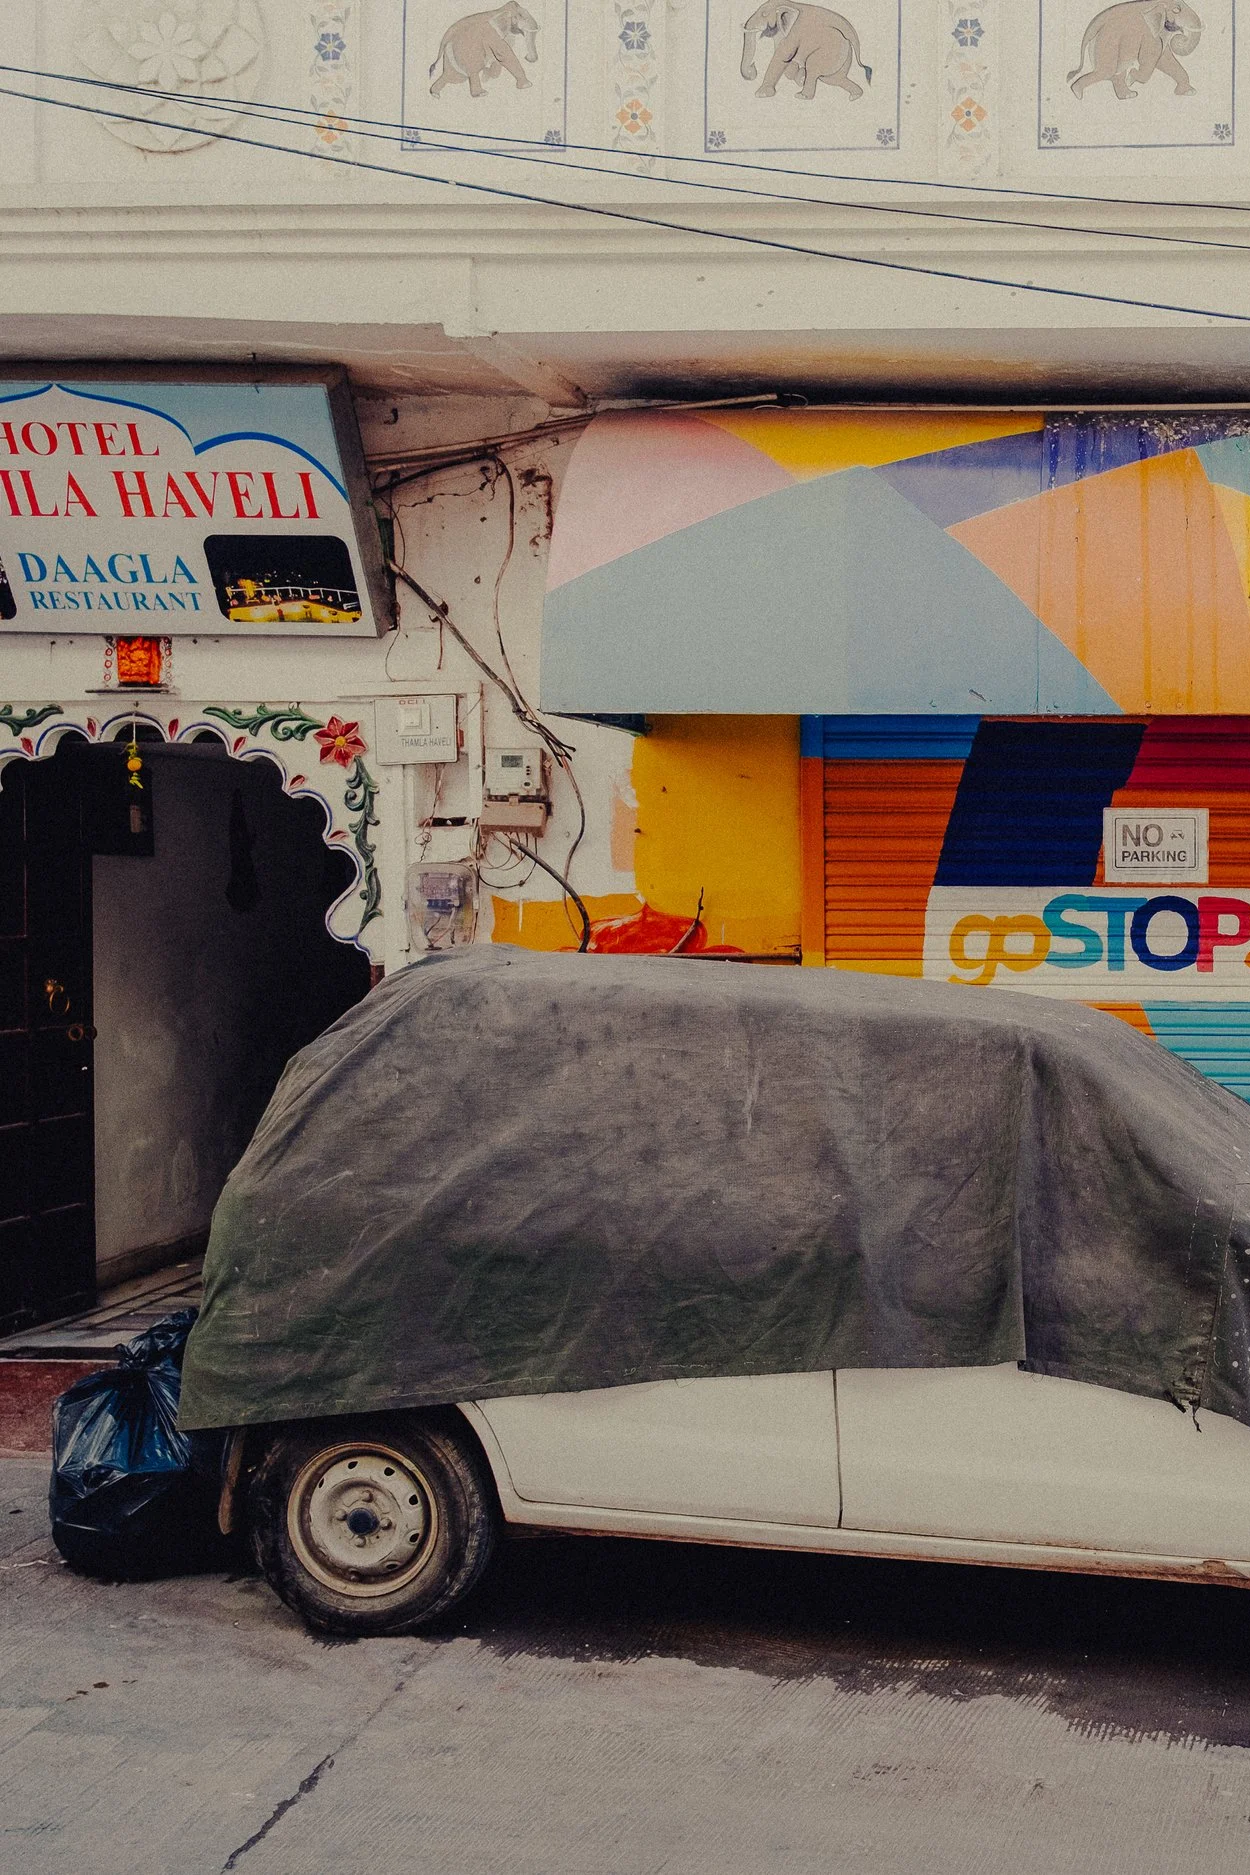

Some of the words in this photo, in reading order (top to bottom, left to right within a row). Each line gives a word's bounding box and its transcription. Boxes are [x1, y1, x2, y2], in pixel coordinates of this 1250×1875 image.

[0, 421, 160, 456] HOTEL
[111, 470, 322, 519] HAVELI
[17, 551, 199, 584] DAAGLA
[28, 590, 203, 612] RESTAURANT
[1121, 823, 1164, 848] NO
[1121, 850, 1187, 862] PARKING
